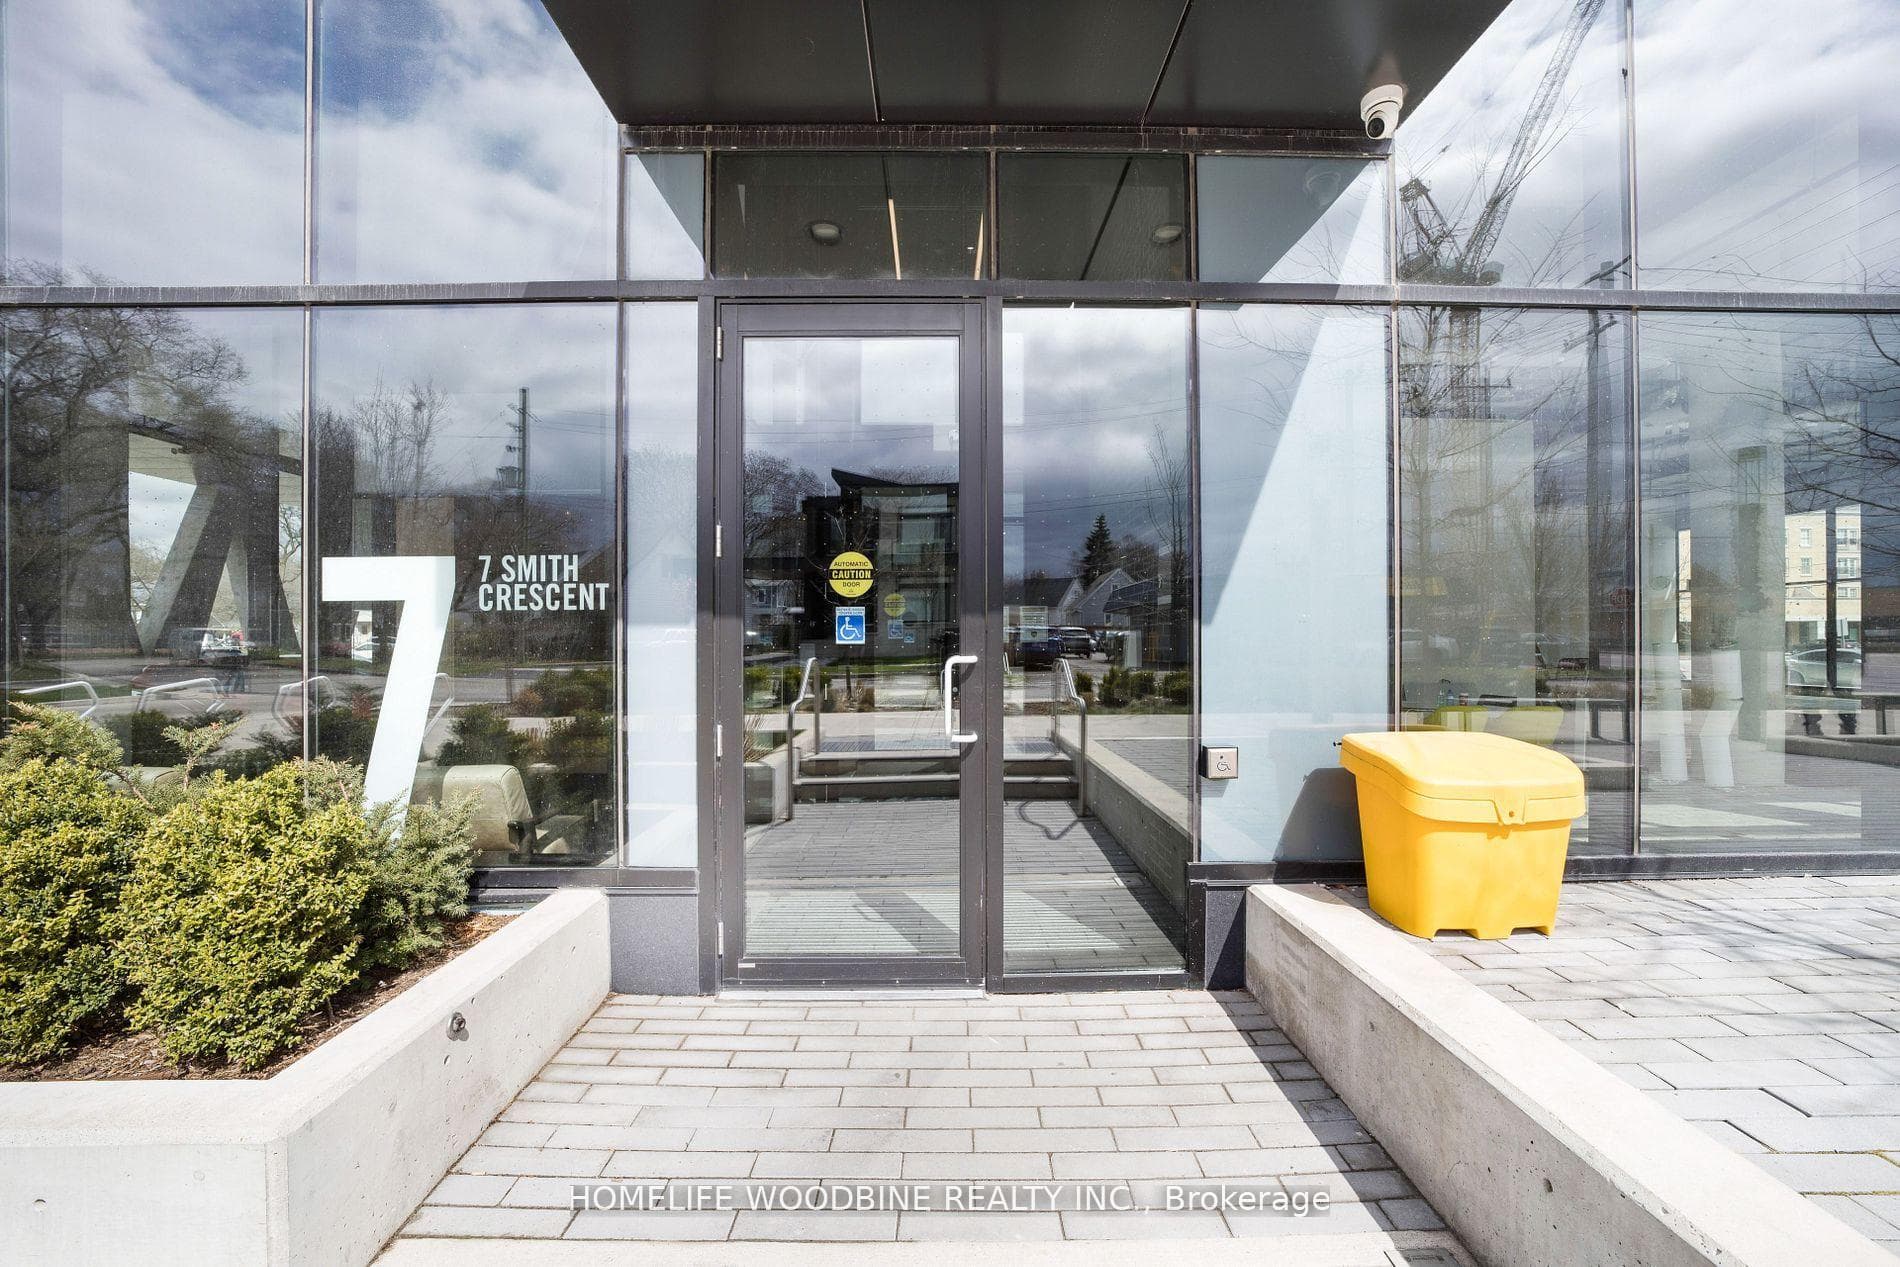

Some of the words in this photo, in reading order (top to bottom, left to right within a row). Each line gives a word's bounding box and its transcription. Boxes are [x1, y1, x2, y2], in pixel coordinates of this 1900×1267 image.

[478, 555, 491, 582] 7
[501, 555, 578, 582] SMITH
[832, 570, 871, 579] CAUTION
[478, 583, 609, 611] CRESCENT
[322, 556, 455, 842] 7
